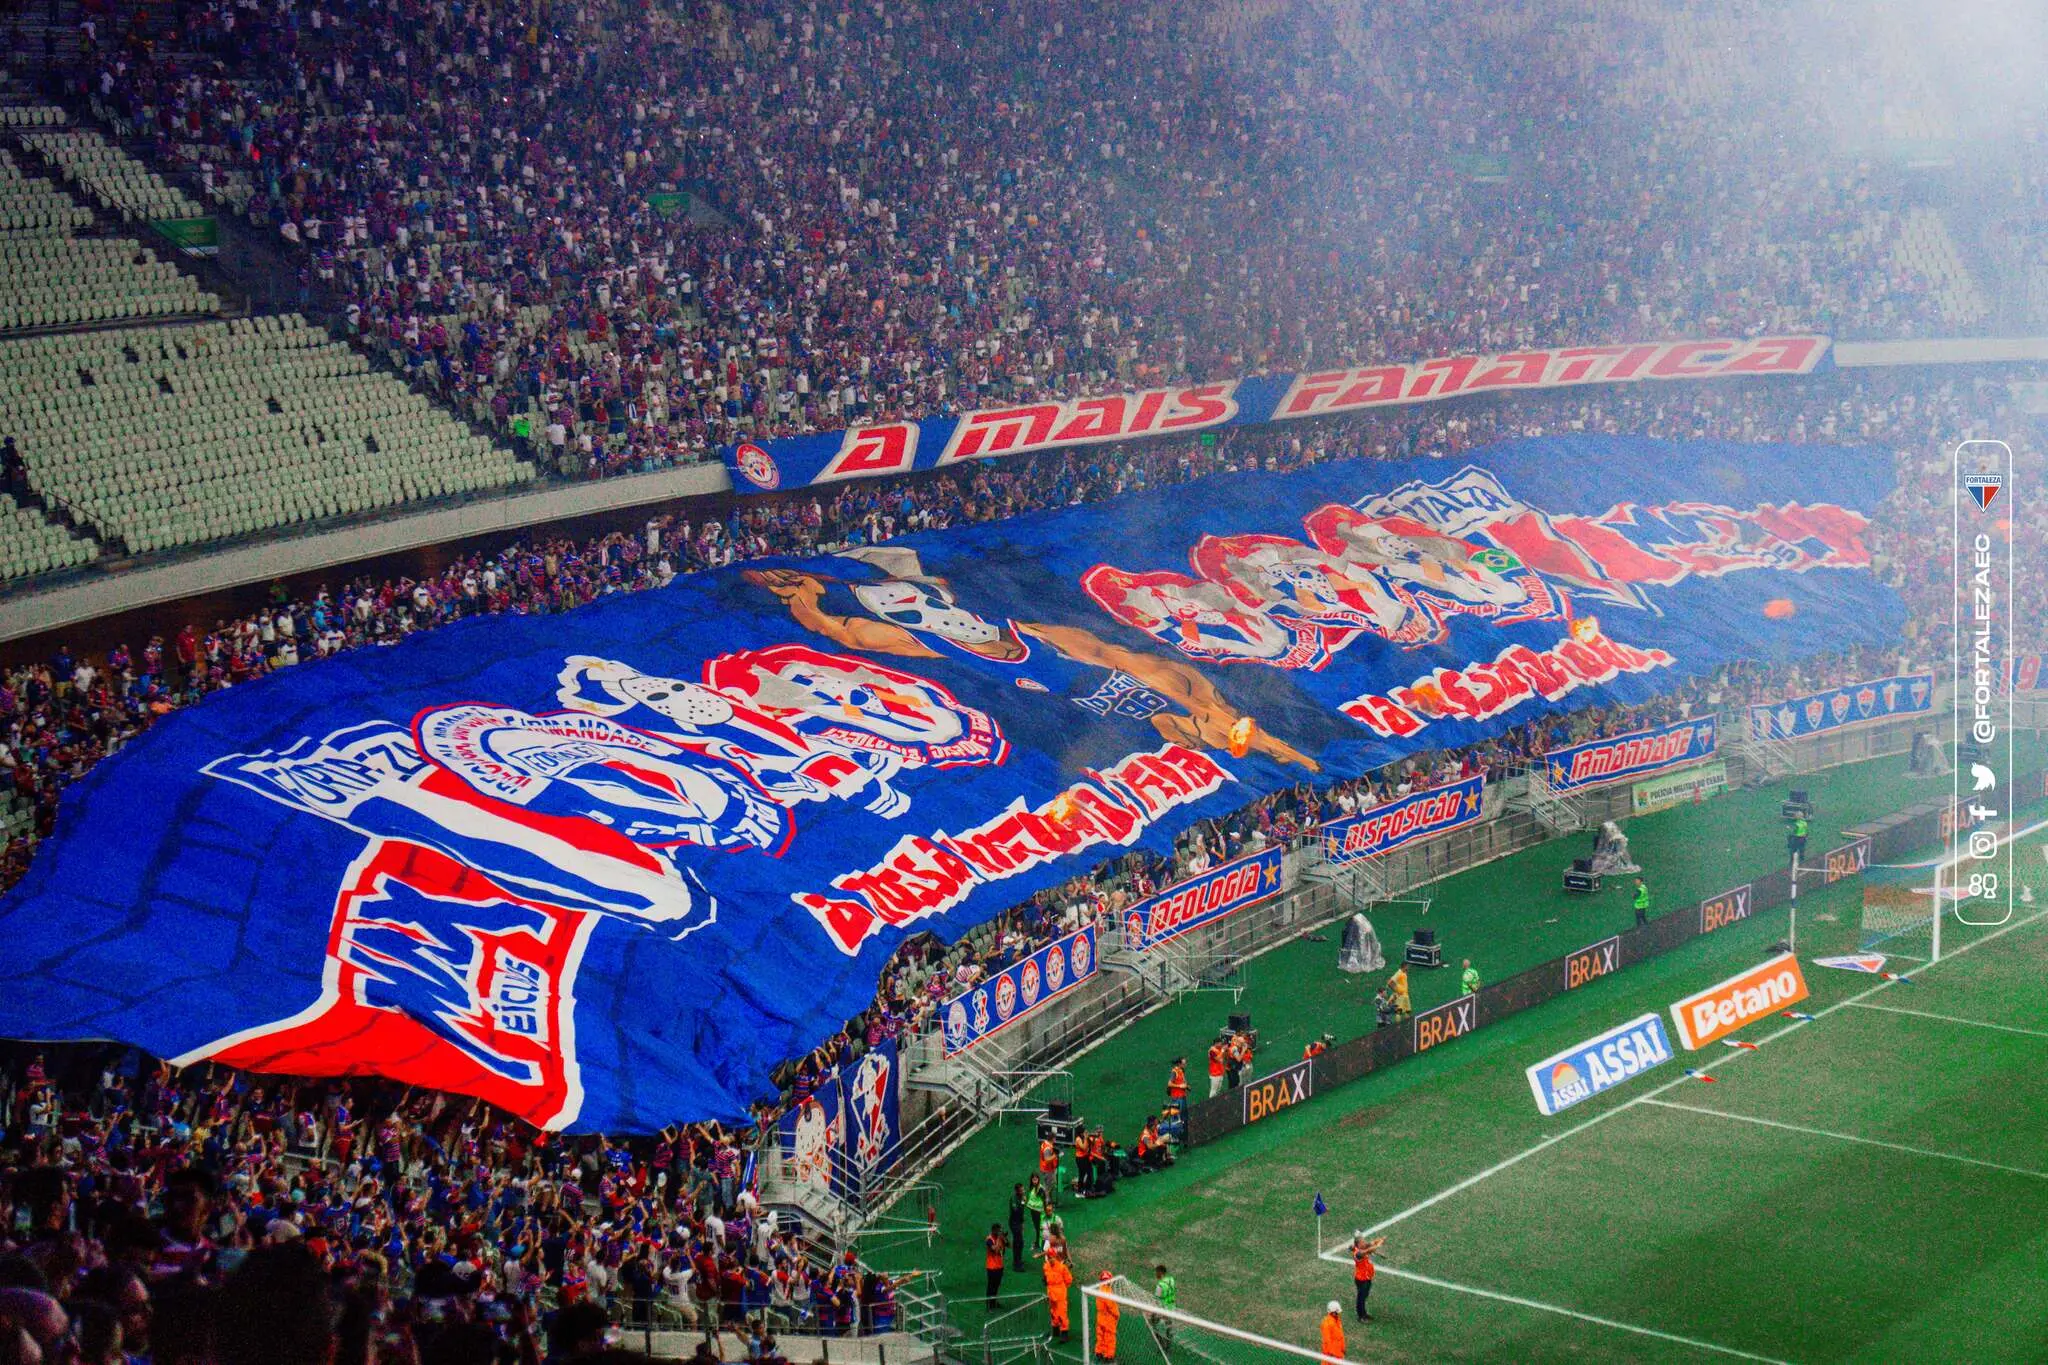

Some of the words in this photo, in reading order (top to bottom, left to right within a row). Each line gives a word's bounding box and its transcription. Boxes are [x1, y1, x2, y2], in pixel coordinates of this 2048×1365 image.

[1570, 727, 1694, 782] IRMANDADE
[1344, 790, 1461, 853] DISPOSIÇÃO
[1828, 844, 1867, 882] BRAX
[1146, 862, 1261, 941] IDEOLOGIA
[1704, 892, 1747, 932] BRAX
[1570, 943, 1615, 988] BRAX
[1419, 1003, 1471, 1051] BRAX
[1693, 971, 1797, 1039] Betano
[1249, 1069, 1307, 1122] BRAX
